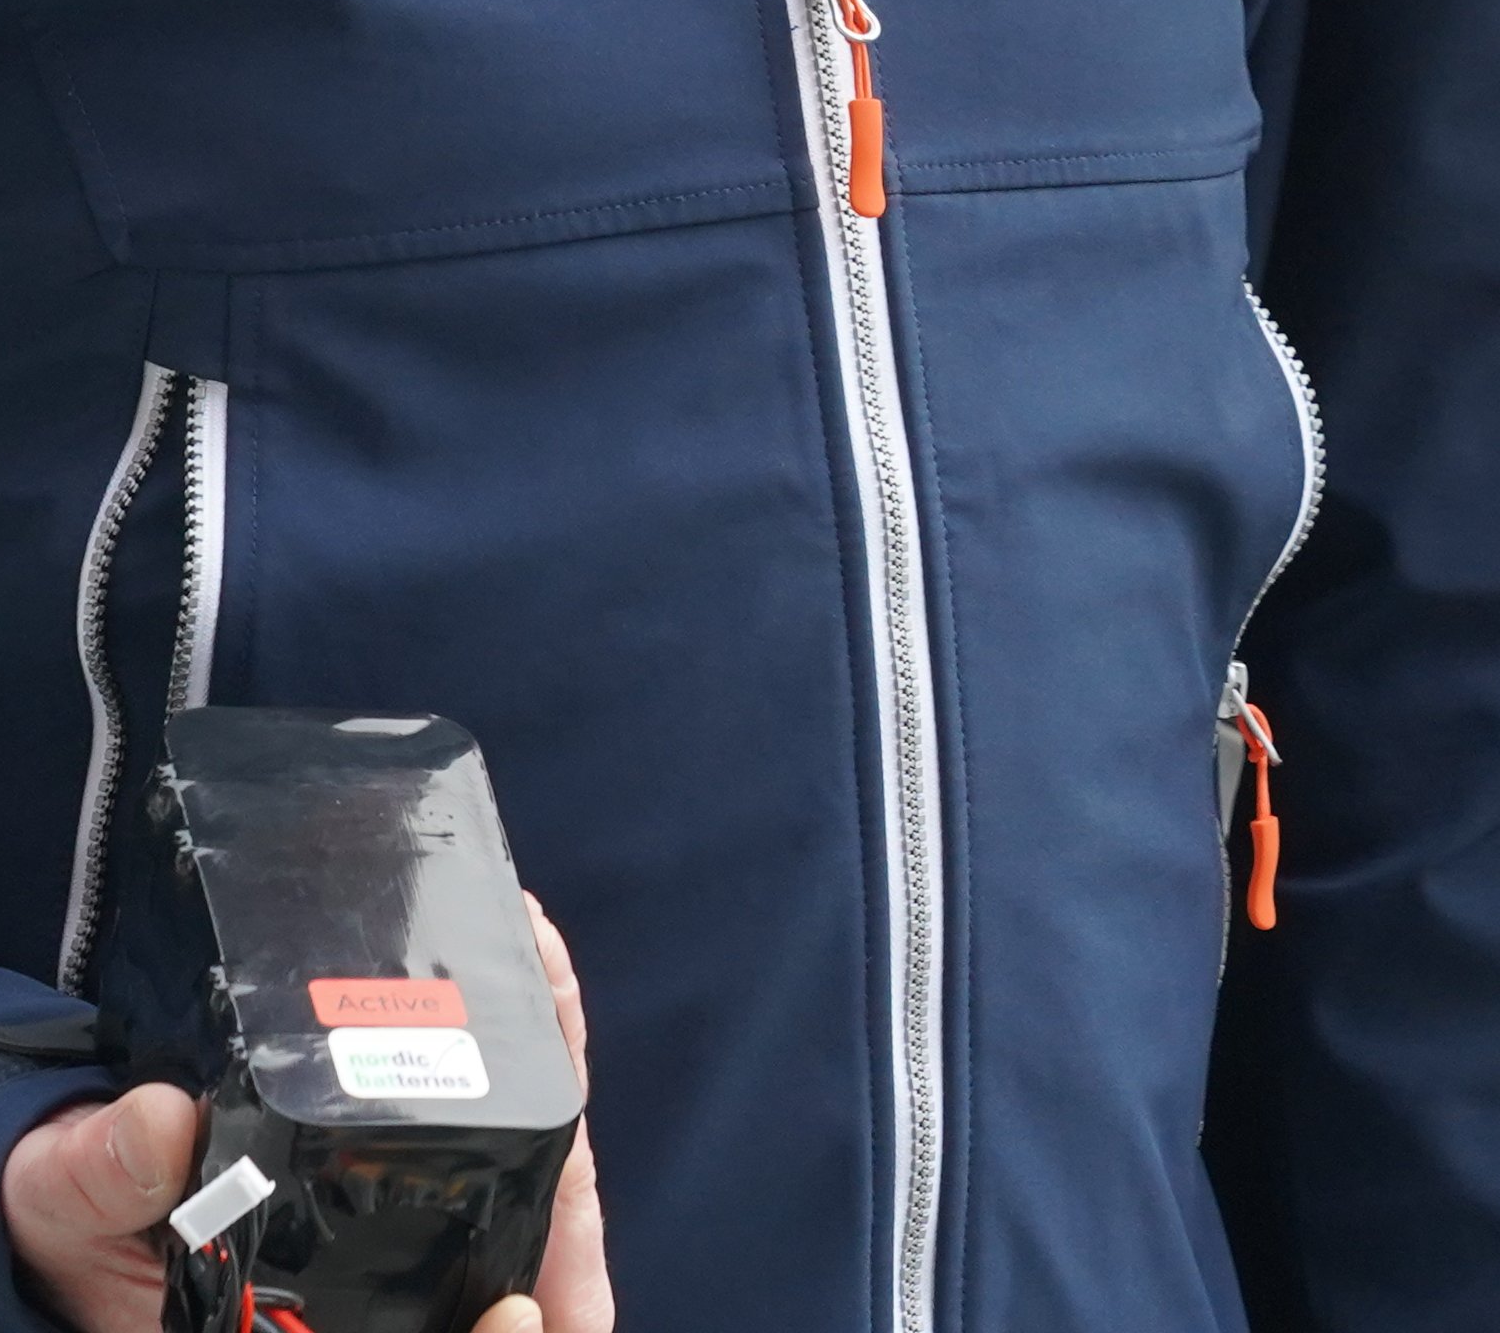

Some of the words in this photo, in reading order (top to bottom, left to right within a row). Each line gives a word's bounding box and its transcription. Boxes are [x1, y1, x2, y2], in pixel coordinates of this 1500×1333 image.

[337, 993, 441, 1013] Active
[348, 1050, 431, 1068] nordic
[355, 1071, 473, 1090] batteries
